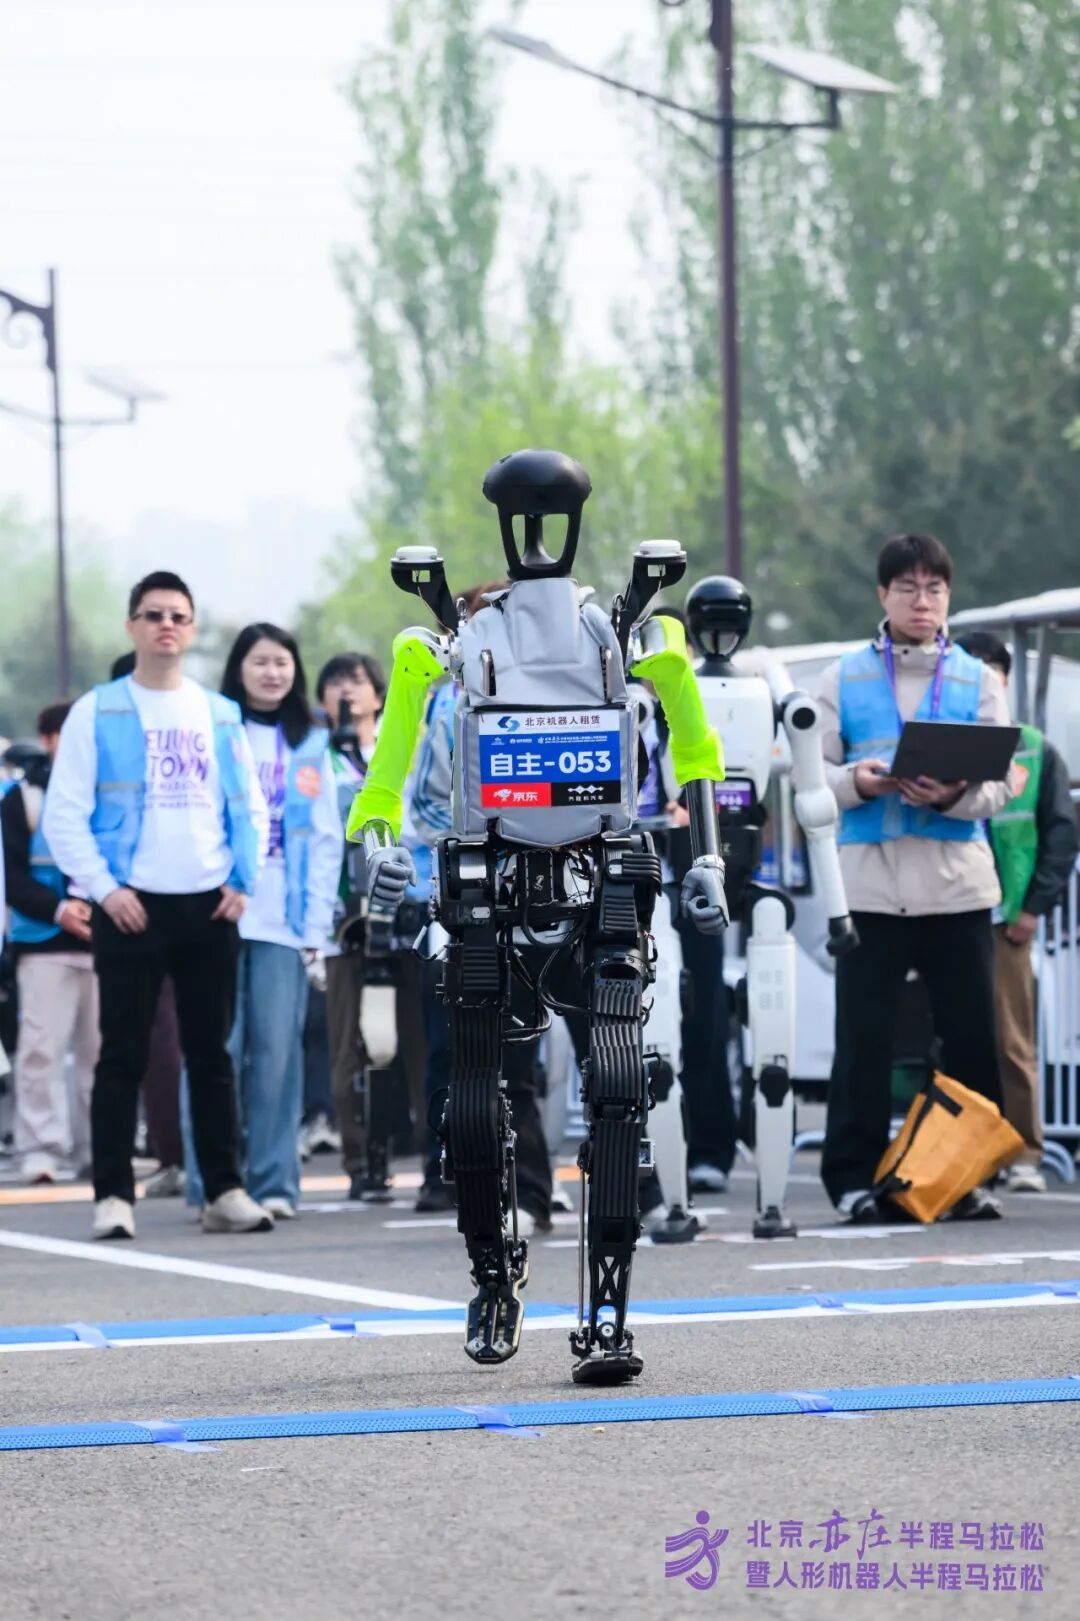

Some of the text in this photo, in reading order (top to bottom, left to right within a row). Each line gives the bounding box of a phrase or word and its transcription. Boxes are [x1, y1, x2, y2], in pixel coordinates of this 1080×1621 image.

[524, 715, 601, 726] 北京机器人租赁
[144, 729, 206, 752] EIJING
[490, 750, 612, 776] 自主-053
[513, 791, 539, 802] 京东
